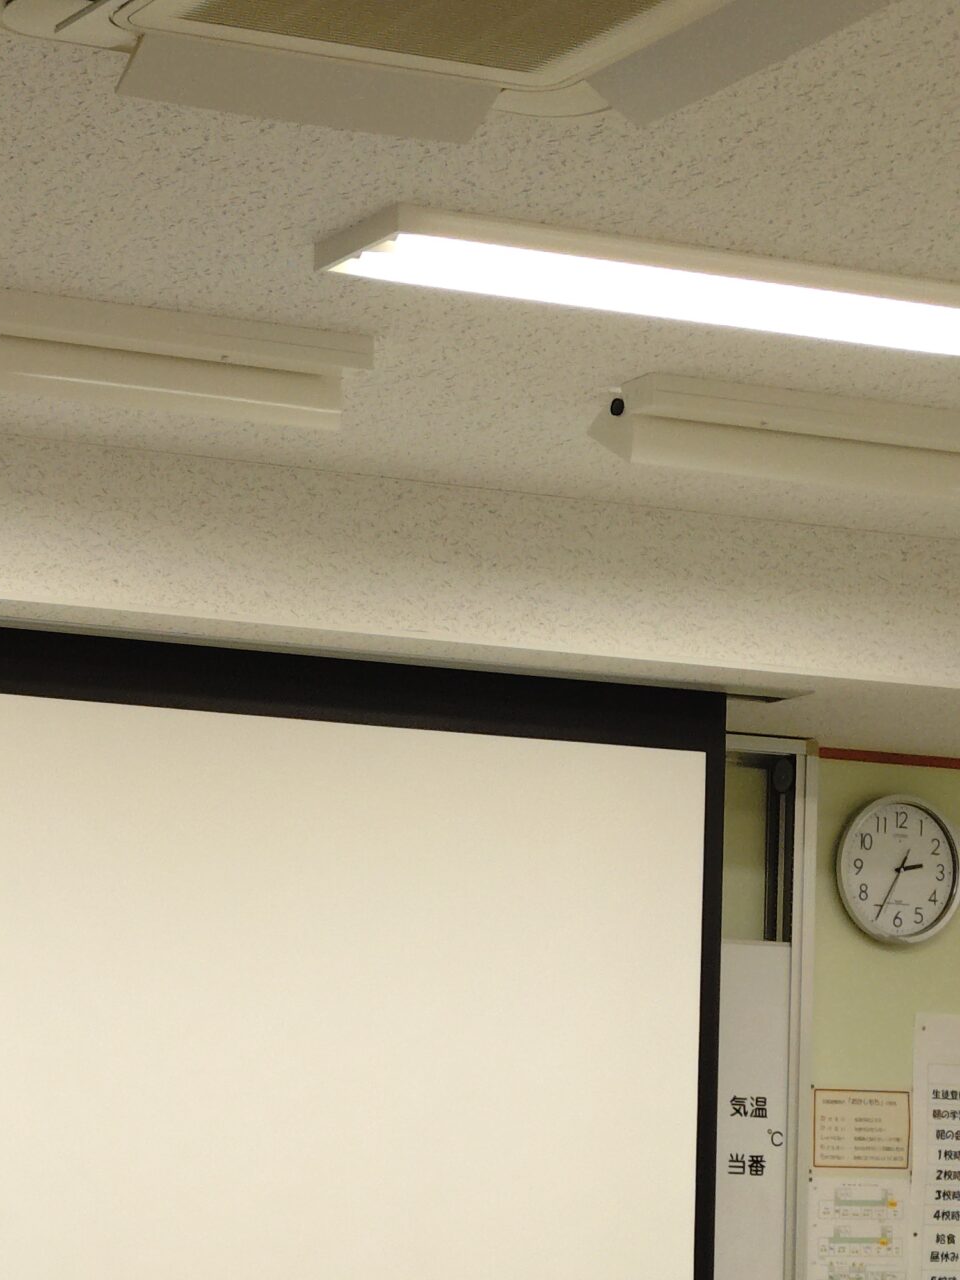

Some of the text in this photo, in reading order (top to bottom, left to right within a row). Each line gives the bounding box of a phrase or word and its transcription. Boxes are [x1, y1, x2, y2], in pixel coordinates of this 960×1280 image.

[876, 816, 887, 834] 11
[895, 811, 908, 829] 12
[919, 819, 924, 837] 1
[860, 833, 873, 850] 10
[931, 838, 941, 856] 2
[853, 858, 864, 876] 9
[936, 864, 945, 881] 3
[859, 883, 868, 901] 8
[928, 889, 938, 906] 4
[893, 911, 903, 928] 6
[913, 907, 924, 925] 5
[932, 1089, 960, 1100] 生徒登
[729, 1095, 767, 1120] 気温
[728, 1153, 766, 1177] 当番
[933, 1210, 960, 1221] 4校時
[936, 1233, 956, 1244] 給食
[930, 1251, 959, 1262] 昼休み
